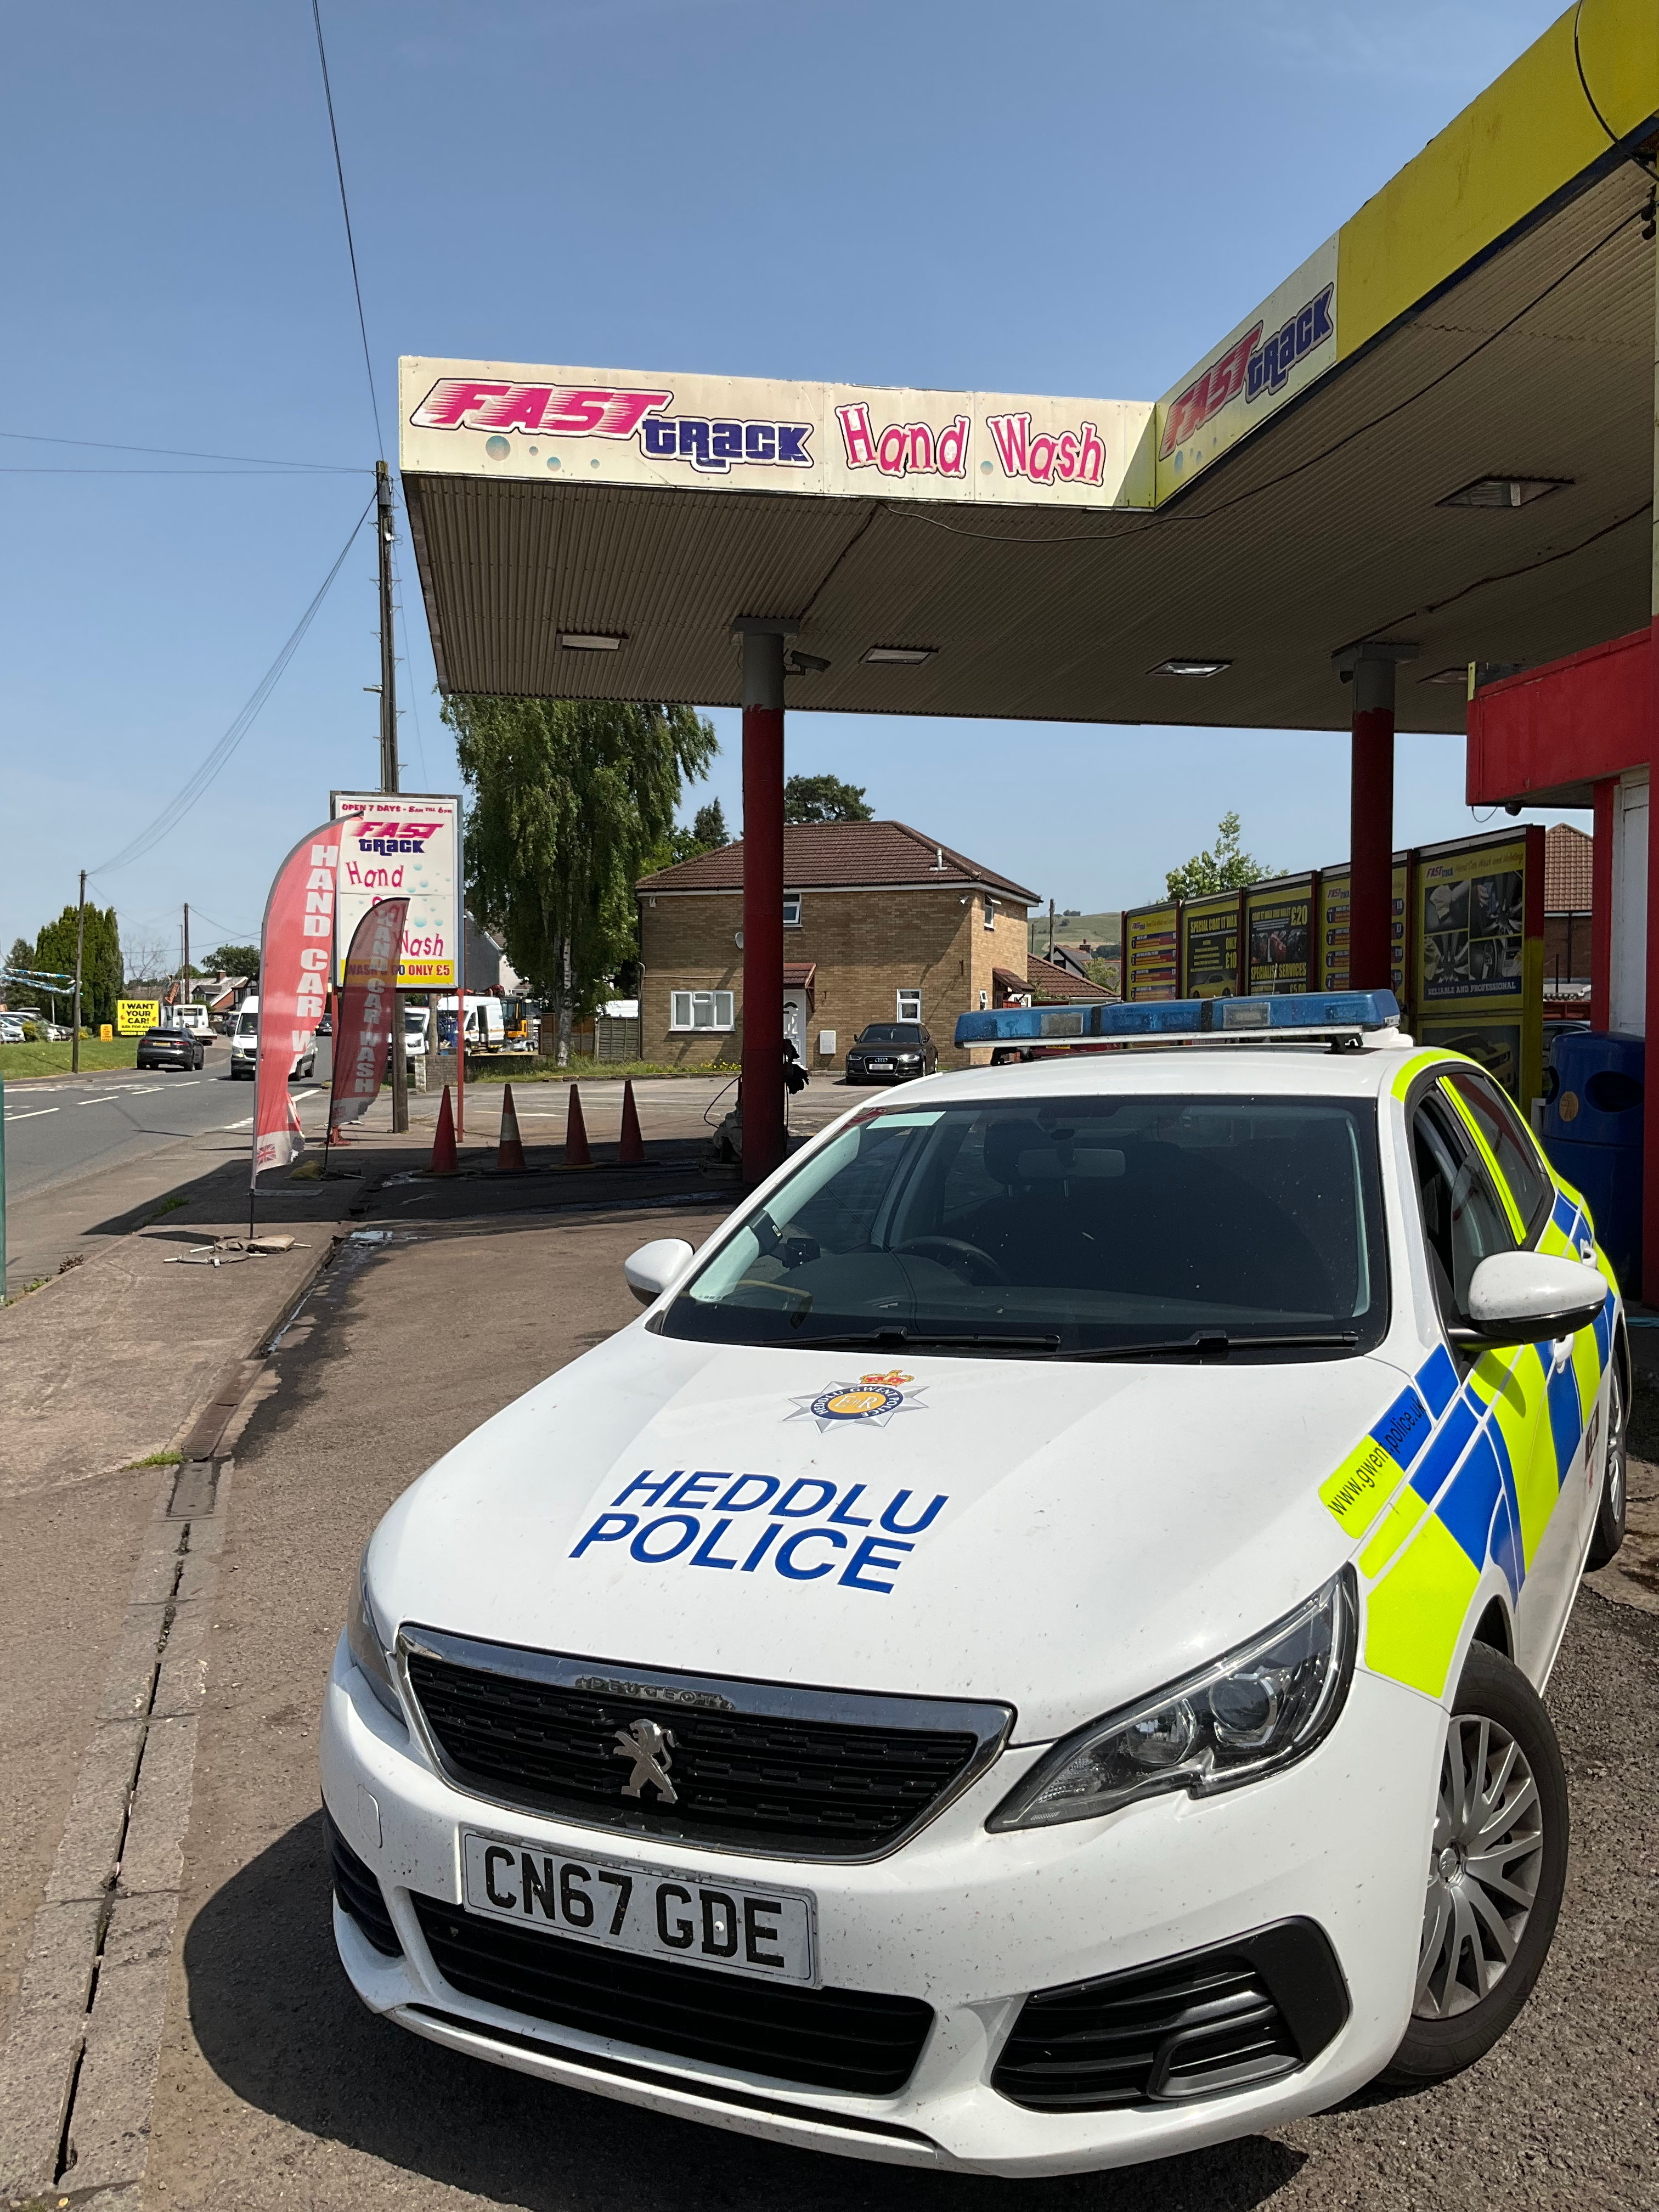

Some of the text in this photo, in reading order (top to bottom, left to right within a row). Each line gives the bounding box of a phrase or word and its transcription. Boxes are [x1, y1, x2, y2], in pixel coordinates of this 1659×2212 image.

[1161, 324, 1262, 456] FAST
[421, 382, 670, 437] FAST
[837, 405, 968, 476] Hand
[989, 414, 1104, 484] Wash
[349, 821, 444, 839] FAST
[346, 861, 404, 888] Hand
[1426, 865, 1443, 878] FAST
[303, 844, 338, 936] HAND
[1190, 919, 1209, 933] SPECIAL
[1209, 917, 1221, 931] COAT
[1221, 916, 1226, 929] IT
[1290, 905, 1308, 927] £20
[1226, 936, 1237, 950] ONLY
[408, 964, 433, 975] ONLY
[436, 964, 450, 975] £5
[1225, 951, 1237, 969] £10
[1279, 962, 1307, 978] SERVICES
[296, 948, 328, 1018] CAR
[1428, 981, 1516, 995] RELIABLE AND PROFESSIONAL
[850, 1386, 898, 1397] GWENT
[860, 1397, 900, 1418] POLICE
[1327, 1396, 1427, 1516] www.gwent.police.uk
[610, 1469, 950, 1534] HEDDLU
[568, 1513, 916, 1594] POLICE
[590, 1676, 713, 1706] PEUGEOT
[484, 1846, 785, 1968] CN67 GDE
